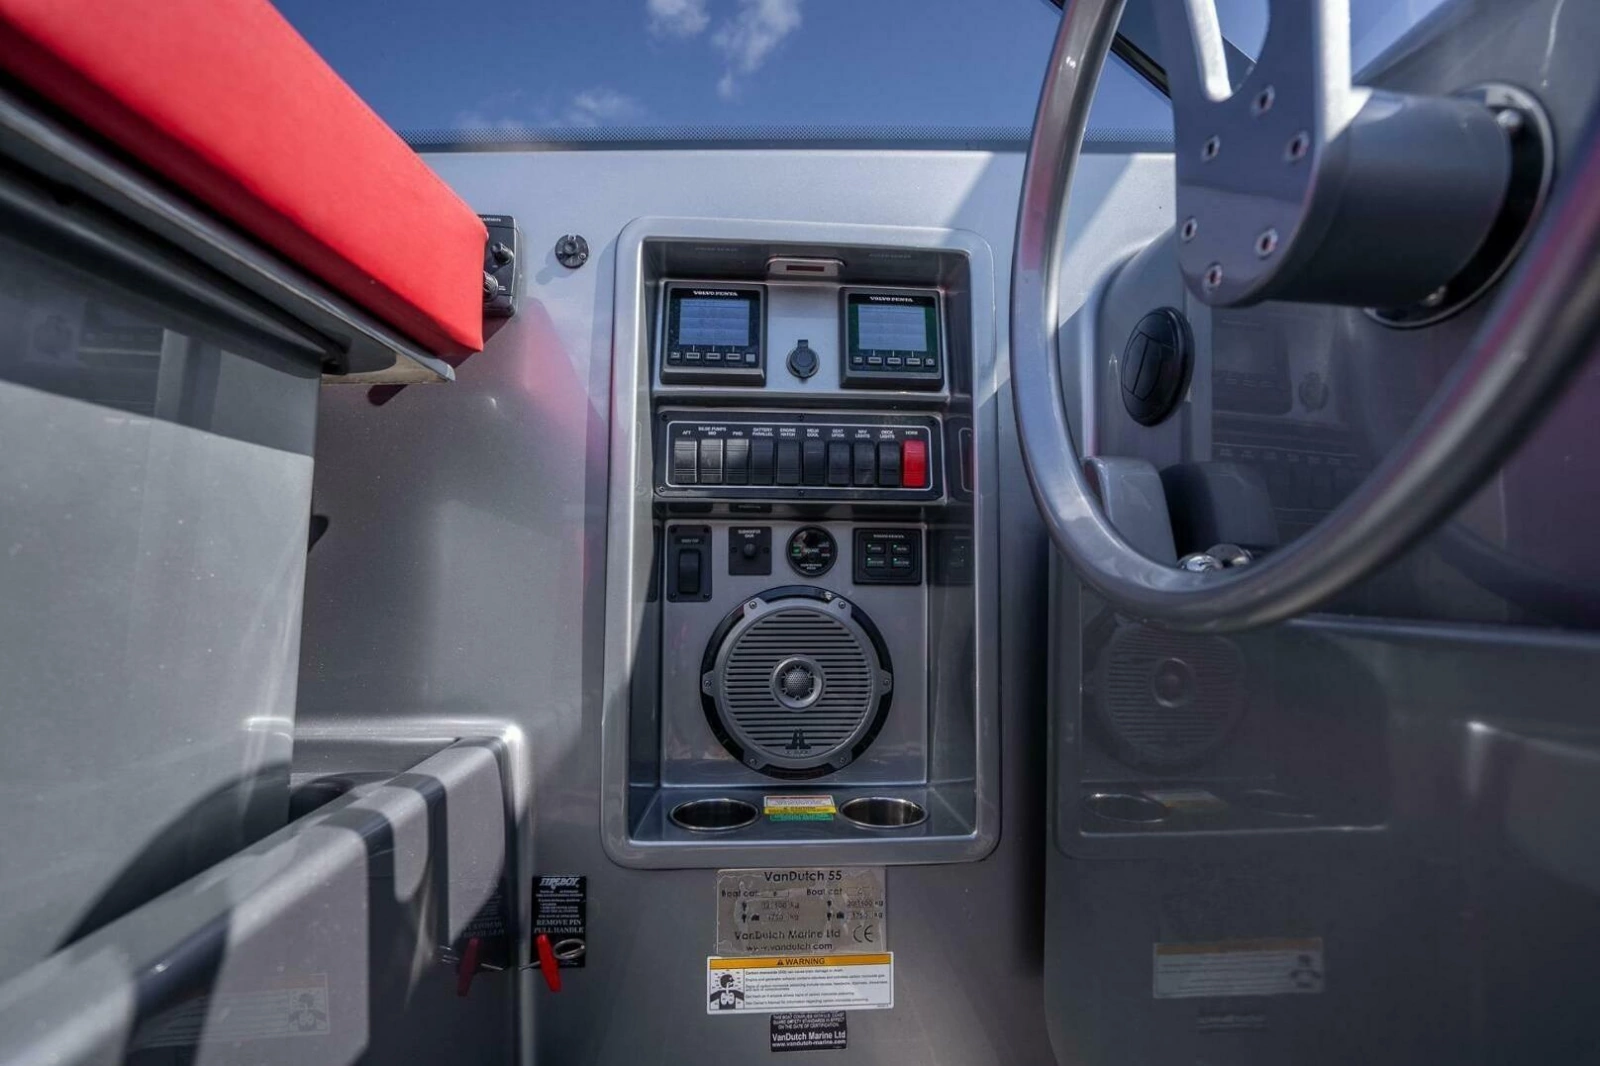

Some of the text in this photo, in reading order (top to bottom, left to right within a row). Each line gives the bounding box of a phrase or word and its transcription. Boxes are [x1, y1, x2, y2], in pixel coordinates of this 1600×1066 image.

[764, 870, 842, 881] VanDutch 55
[734, 929, 840, 940] VanDutch Marine Ltd
[772, 1032, 806, 1041] VanDutch
[809, 1031, 832, 1040] Marine
